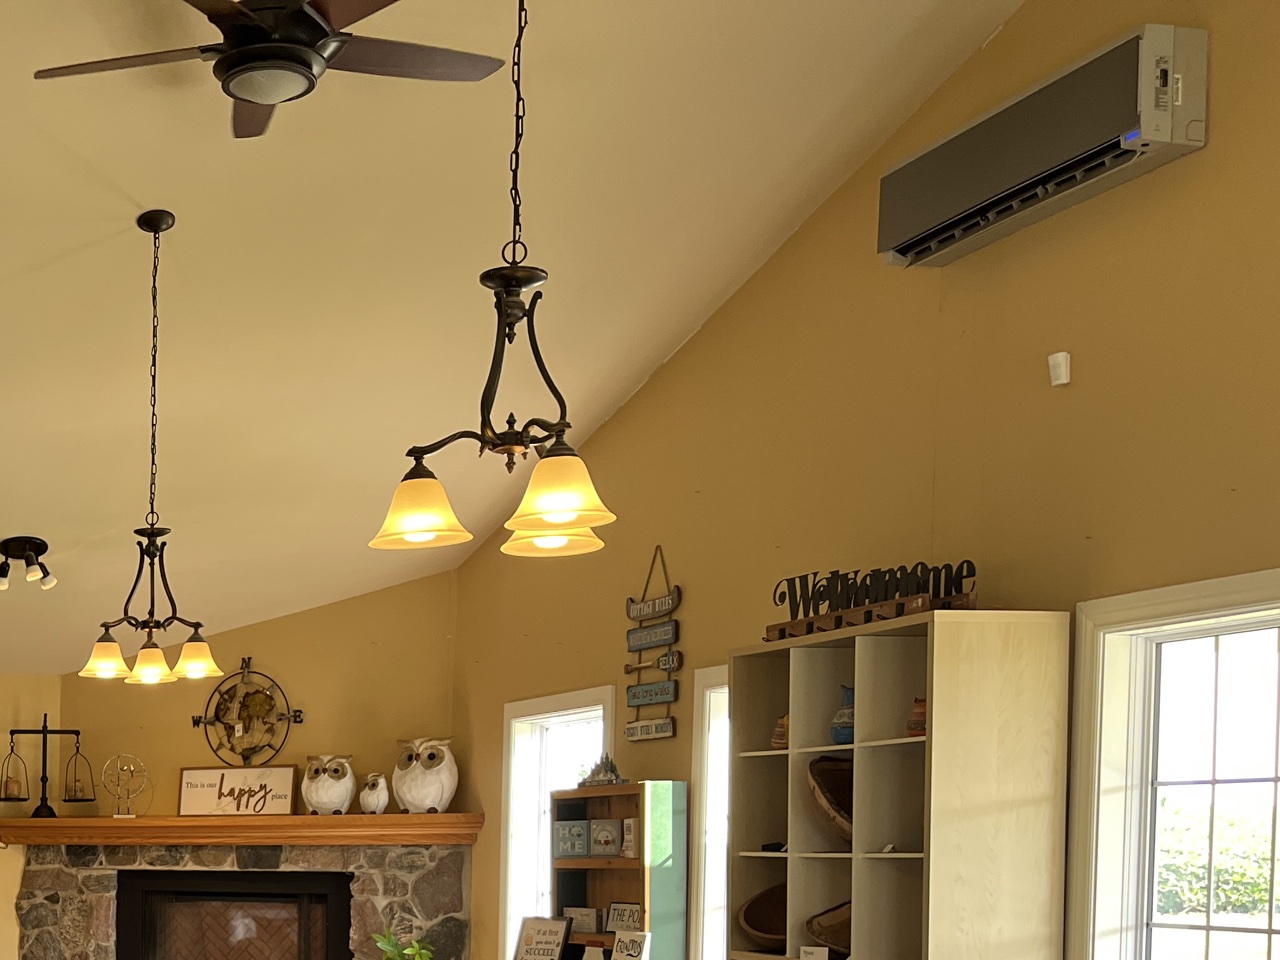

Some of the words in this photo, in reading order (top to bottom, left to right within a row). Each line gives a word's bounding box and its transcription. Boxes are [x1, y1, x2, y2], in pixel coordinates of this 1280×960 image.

[240, 656, 252, 671] N
[192, 715, 204, 728] W
[292, 710, 304, 723] E
[185, 781, 199, 789] This
[200, 781, 206, 789] is
[217, 773, 273, 813] happy
[271, 792, 288, 801] place
[612, 908, 627, 922] THE
[548, 928, 559, 936] first
